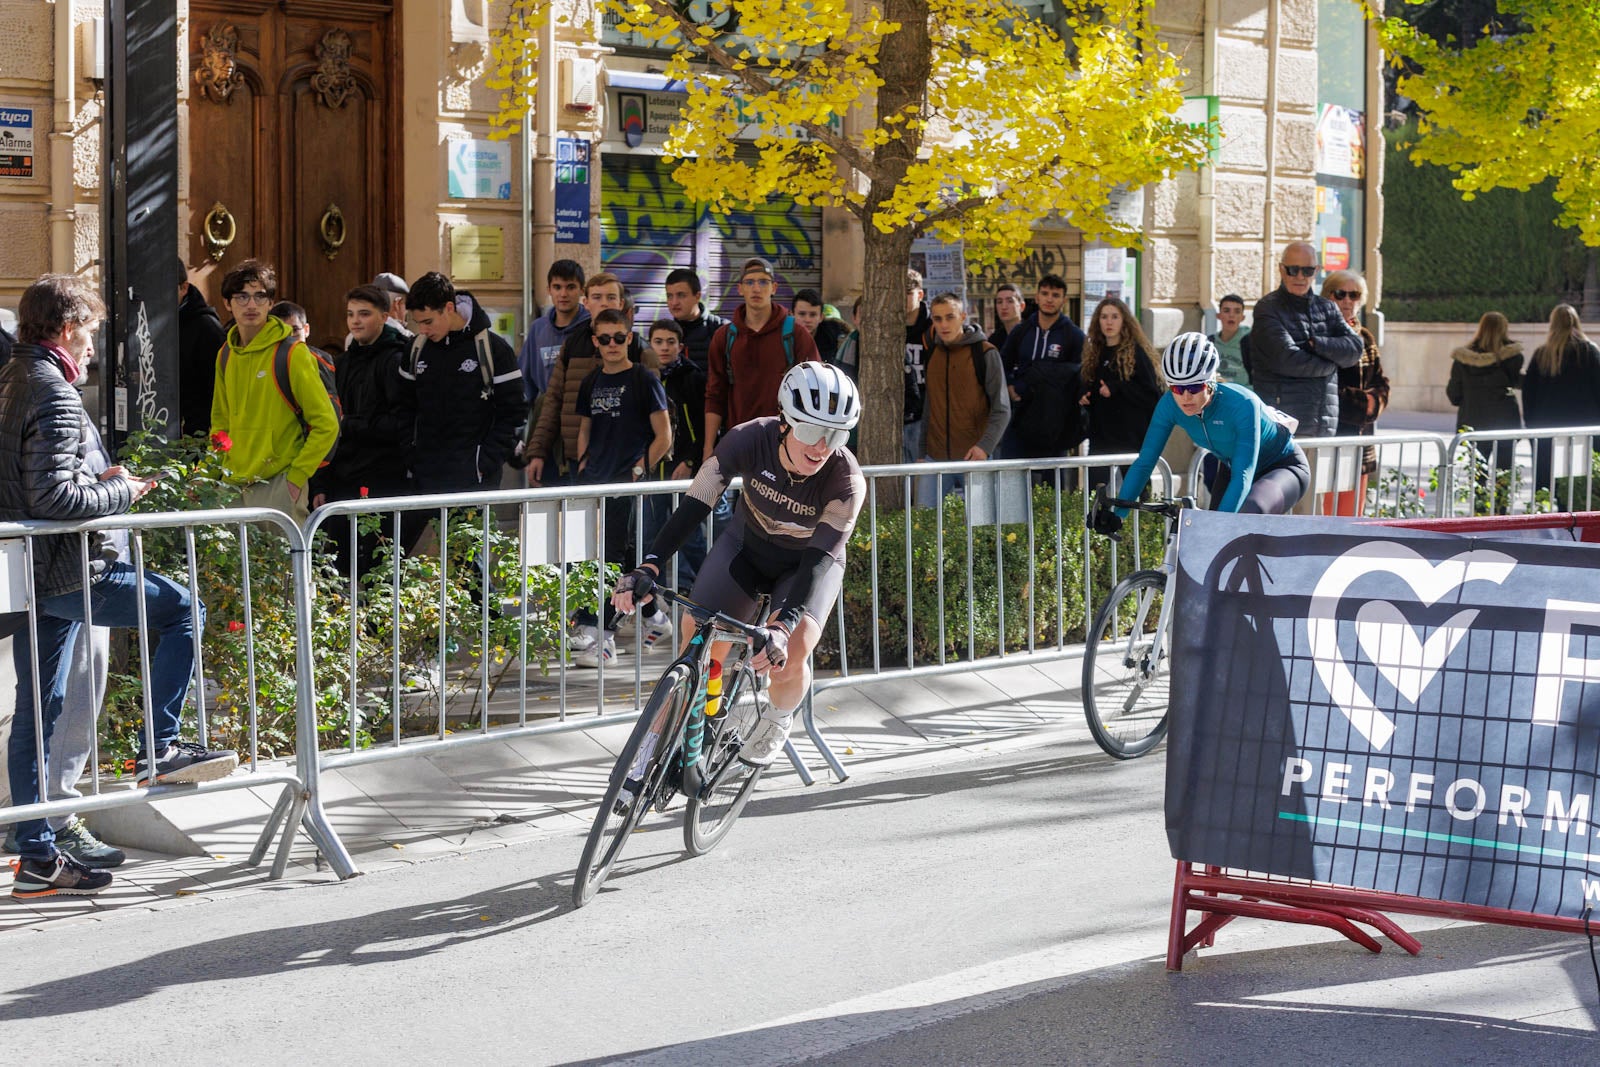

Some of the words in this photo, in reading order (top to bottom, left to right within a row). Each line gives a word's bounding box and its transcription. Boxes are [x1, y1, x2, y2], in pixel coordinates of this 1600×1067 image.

[0, 111, 29, 124] tyco
[649, 124, 669, 134] Estad
[750, 478, 816, 516] DISRUPTORS
[1280, 756, 1600, 840] PERFORM
